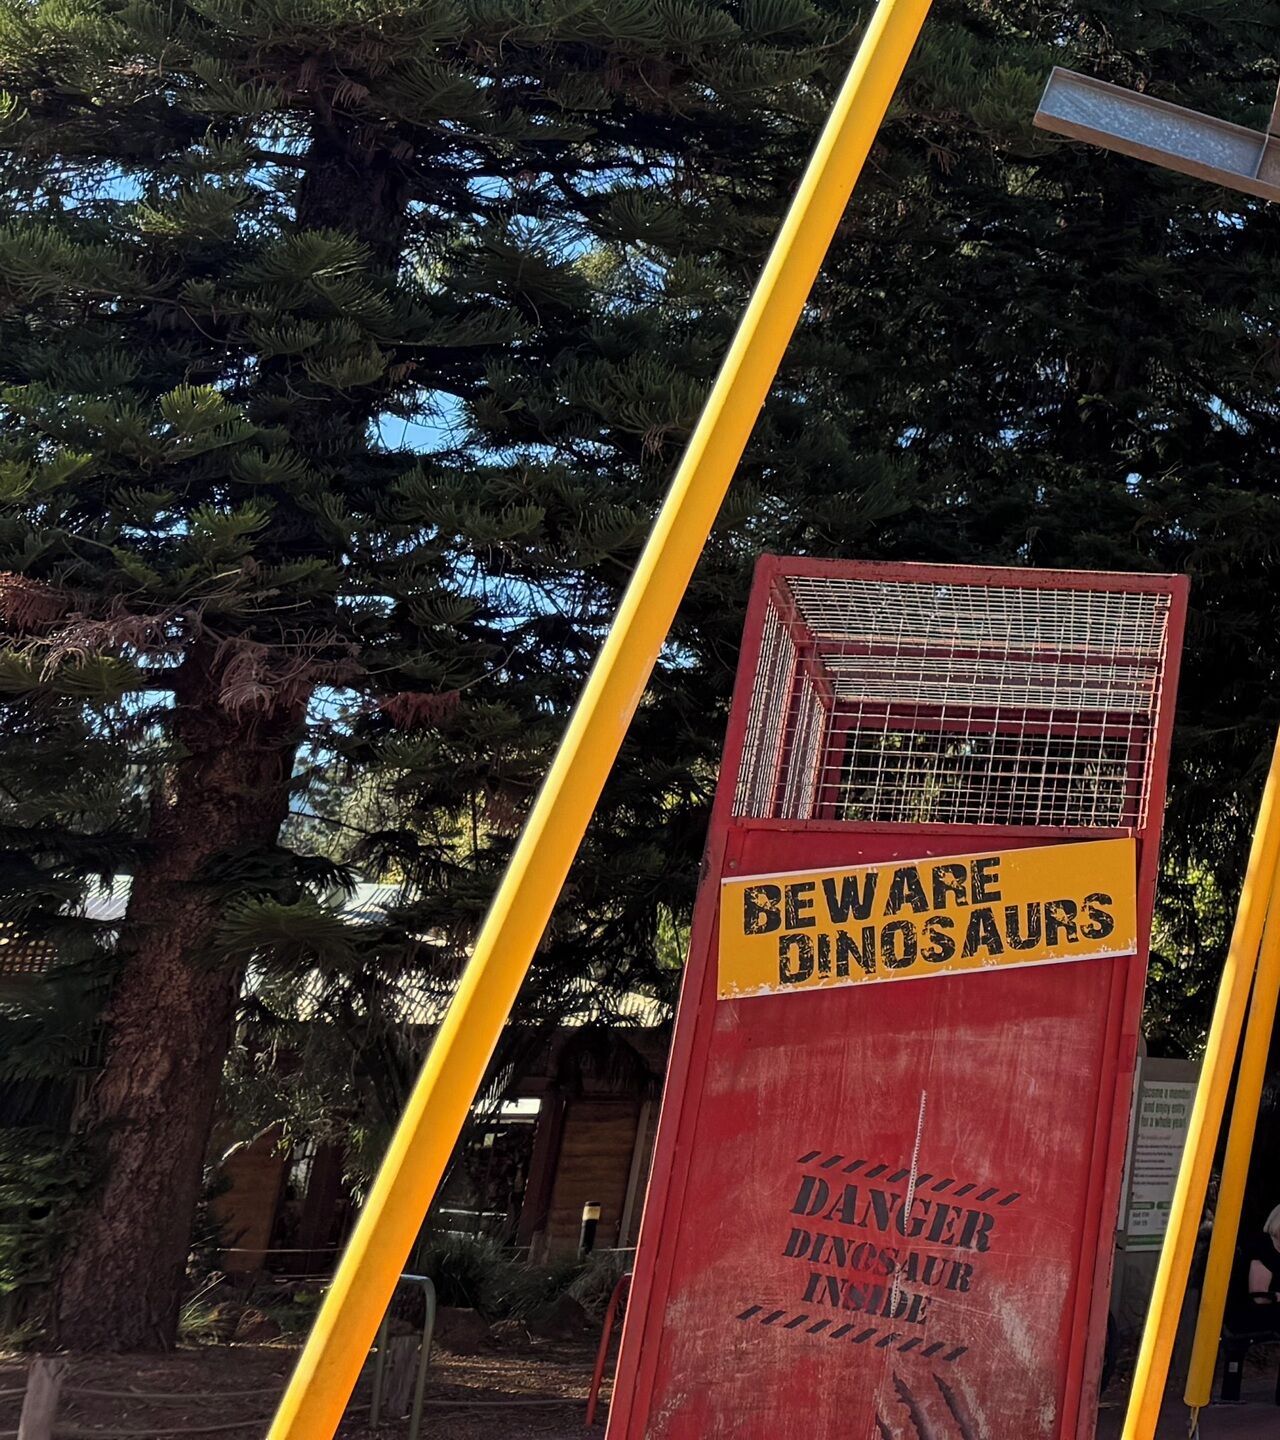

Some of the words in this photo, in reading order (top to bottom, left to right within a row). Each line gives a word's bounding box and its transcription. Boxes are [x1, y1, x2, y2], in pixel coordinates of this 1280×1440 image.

[743, 856, 1002, 936] BEWARE
[778, 892, 1115, 986] DINOSAURS
[789, 1174, 995, 1253] DANGER
[782, 1228, 975, 1294] DINOSAUR
[803, 1272, 932, 1326] INSIDE
